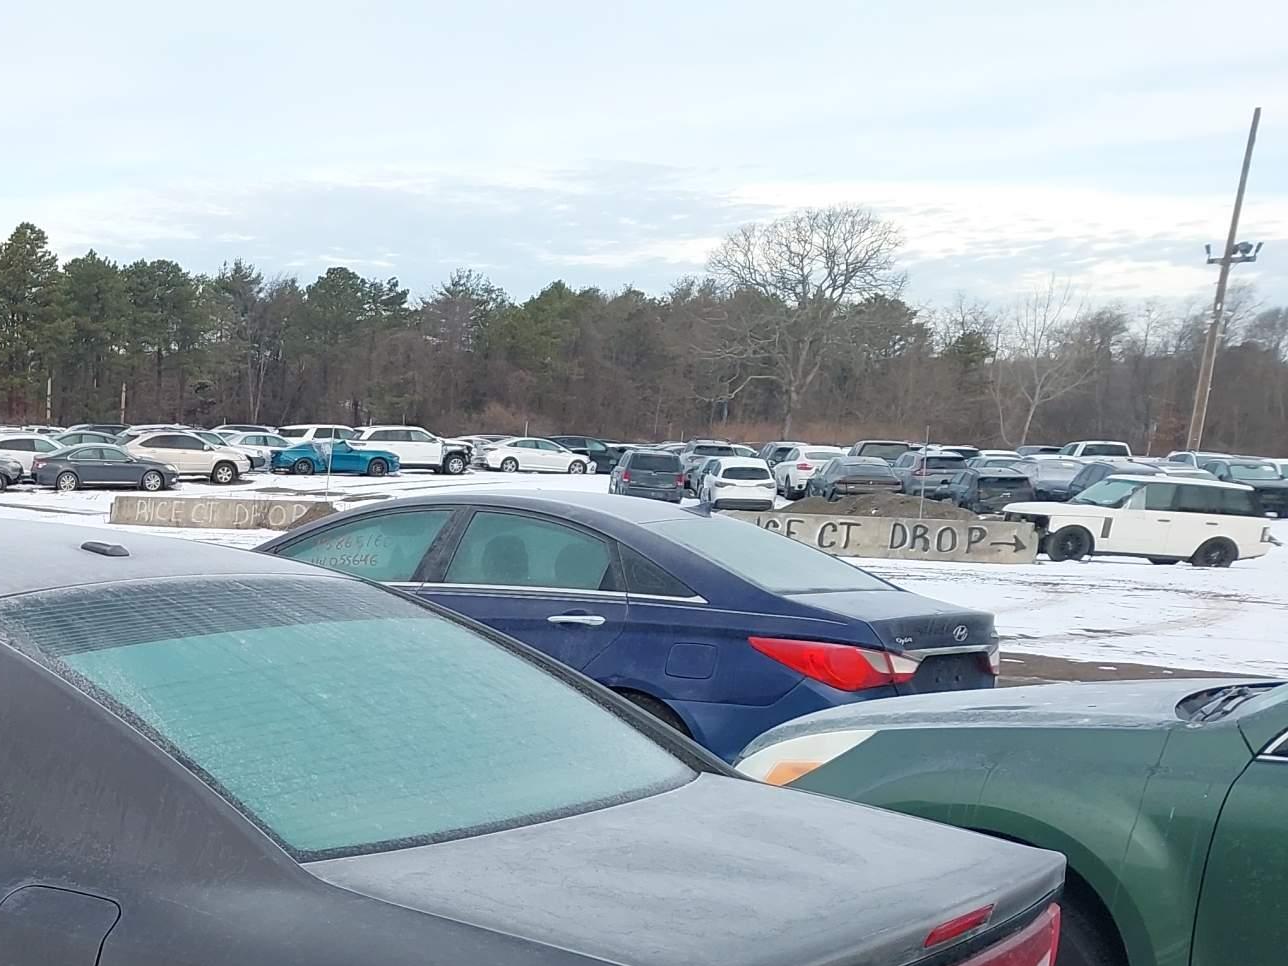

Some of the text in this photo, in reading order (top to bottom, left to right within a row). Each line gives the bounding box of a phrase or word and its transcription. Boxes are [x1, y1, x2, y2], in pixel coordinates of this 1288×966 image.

[191, 501, 219, 524] CT
[817, 519, 862, 550] CT
[888, 521, 988, 554] DROP
